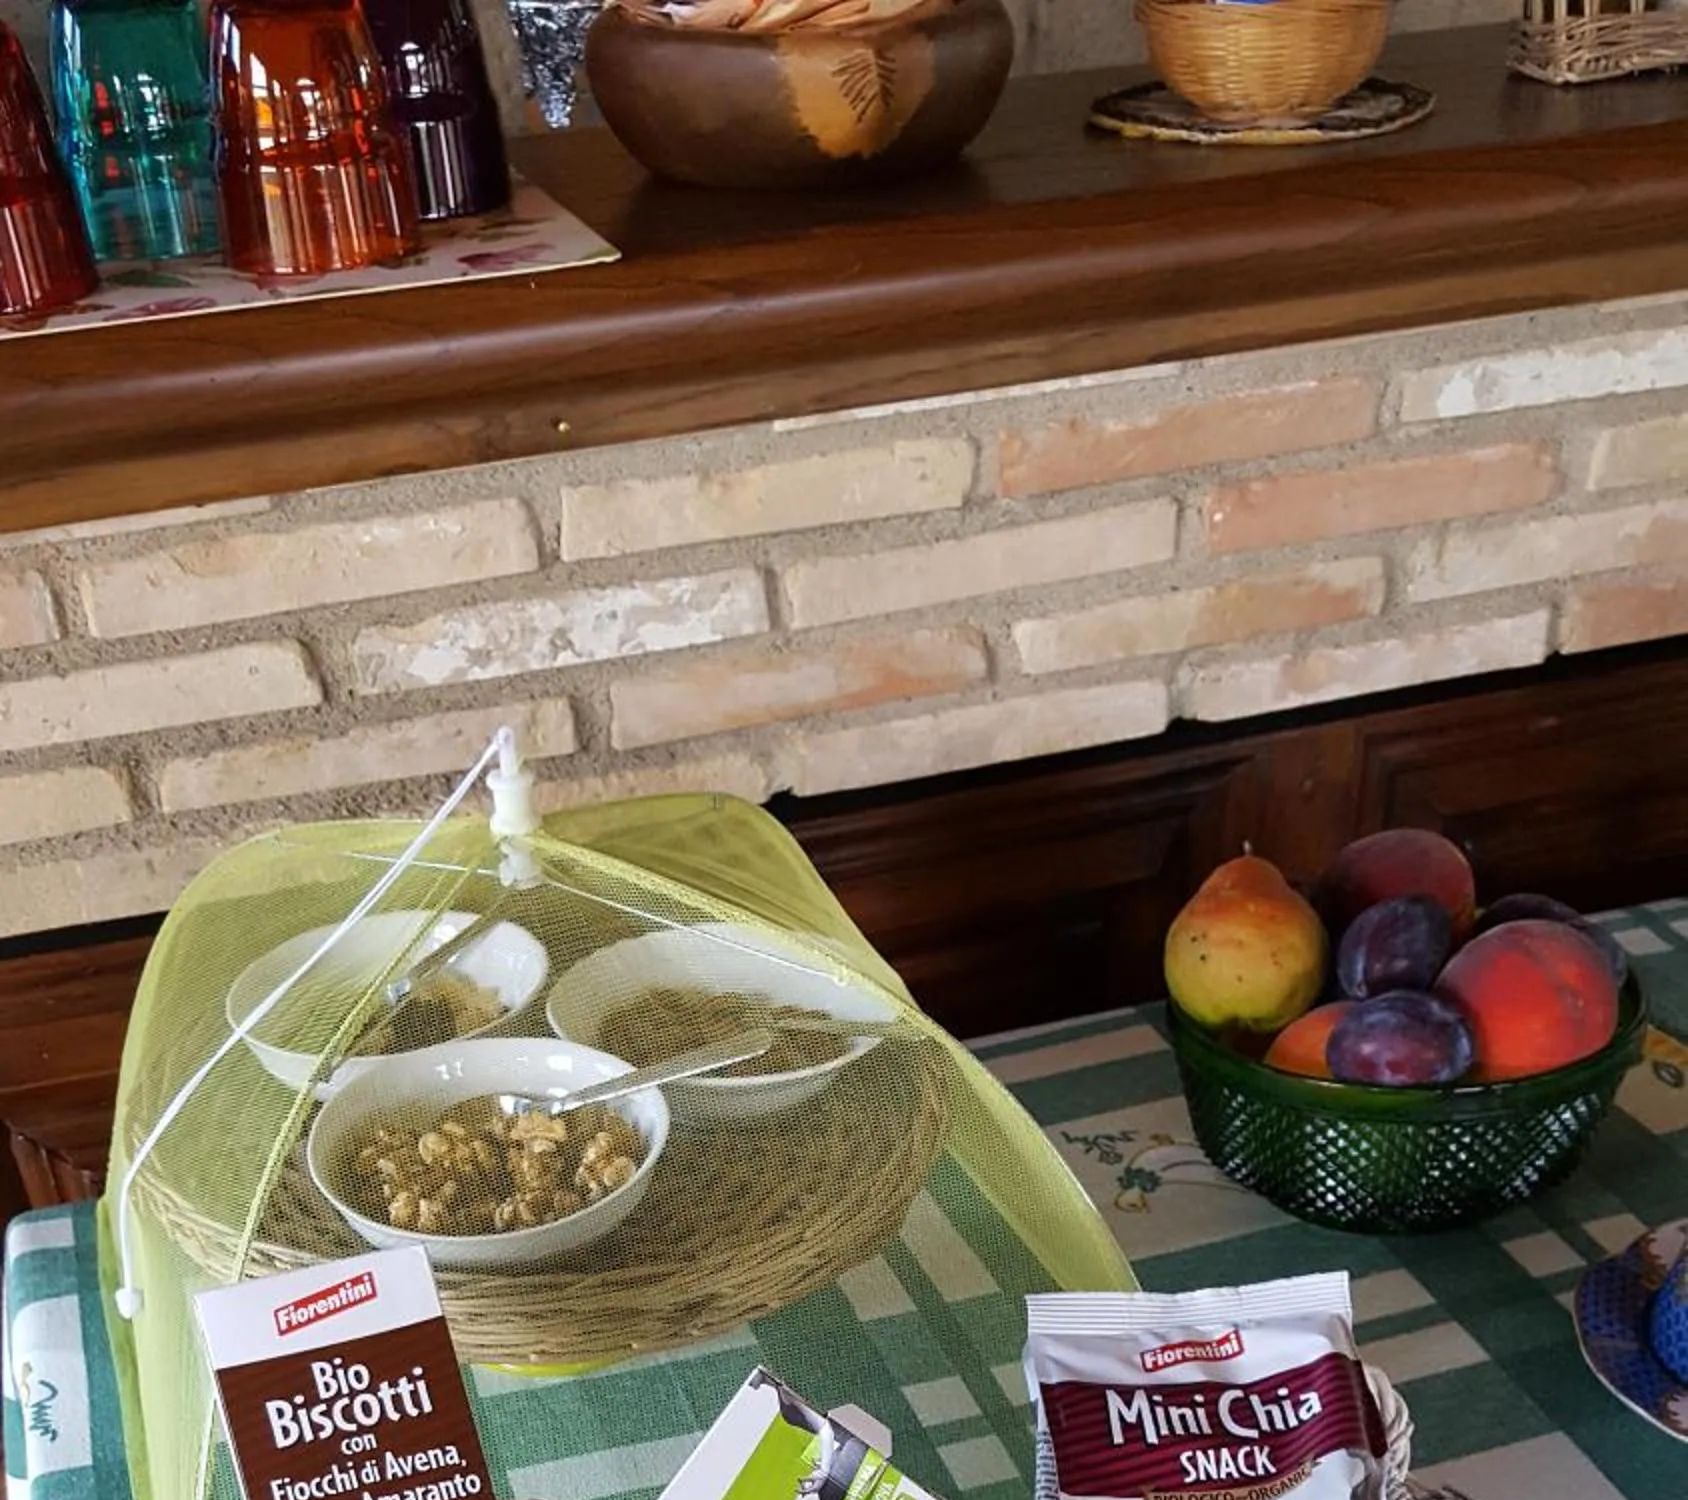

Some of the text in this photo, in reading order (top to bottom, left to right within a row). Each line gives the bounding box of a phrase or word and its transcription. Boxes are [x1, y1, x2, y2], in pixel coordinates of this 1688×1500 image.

[277, 1275, 374, 1331] Fiorentini
[1143, 1331, 1240, 1370] Fiorentini
[311, 1357, 370, 1400] Bio
[265, 1367, 433, 1449] Biscotti
[1105, 1387, 1322, 1446] Mini Chia
[340, 1433, 377, 1455] con
[360, 1459, 380, 1484] di
[385, 1445, 467, 1480] Avena,
[1180, 1446, 1277, 1483] SNACK
